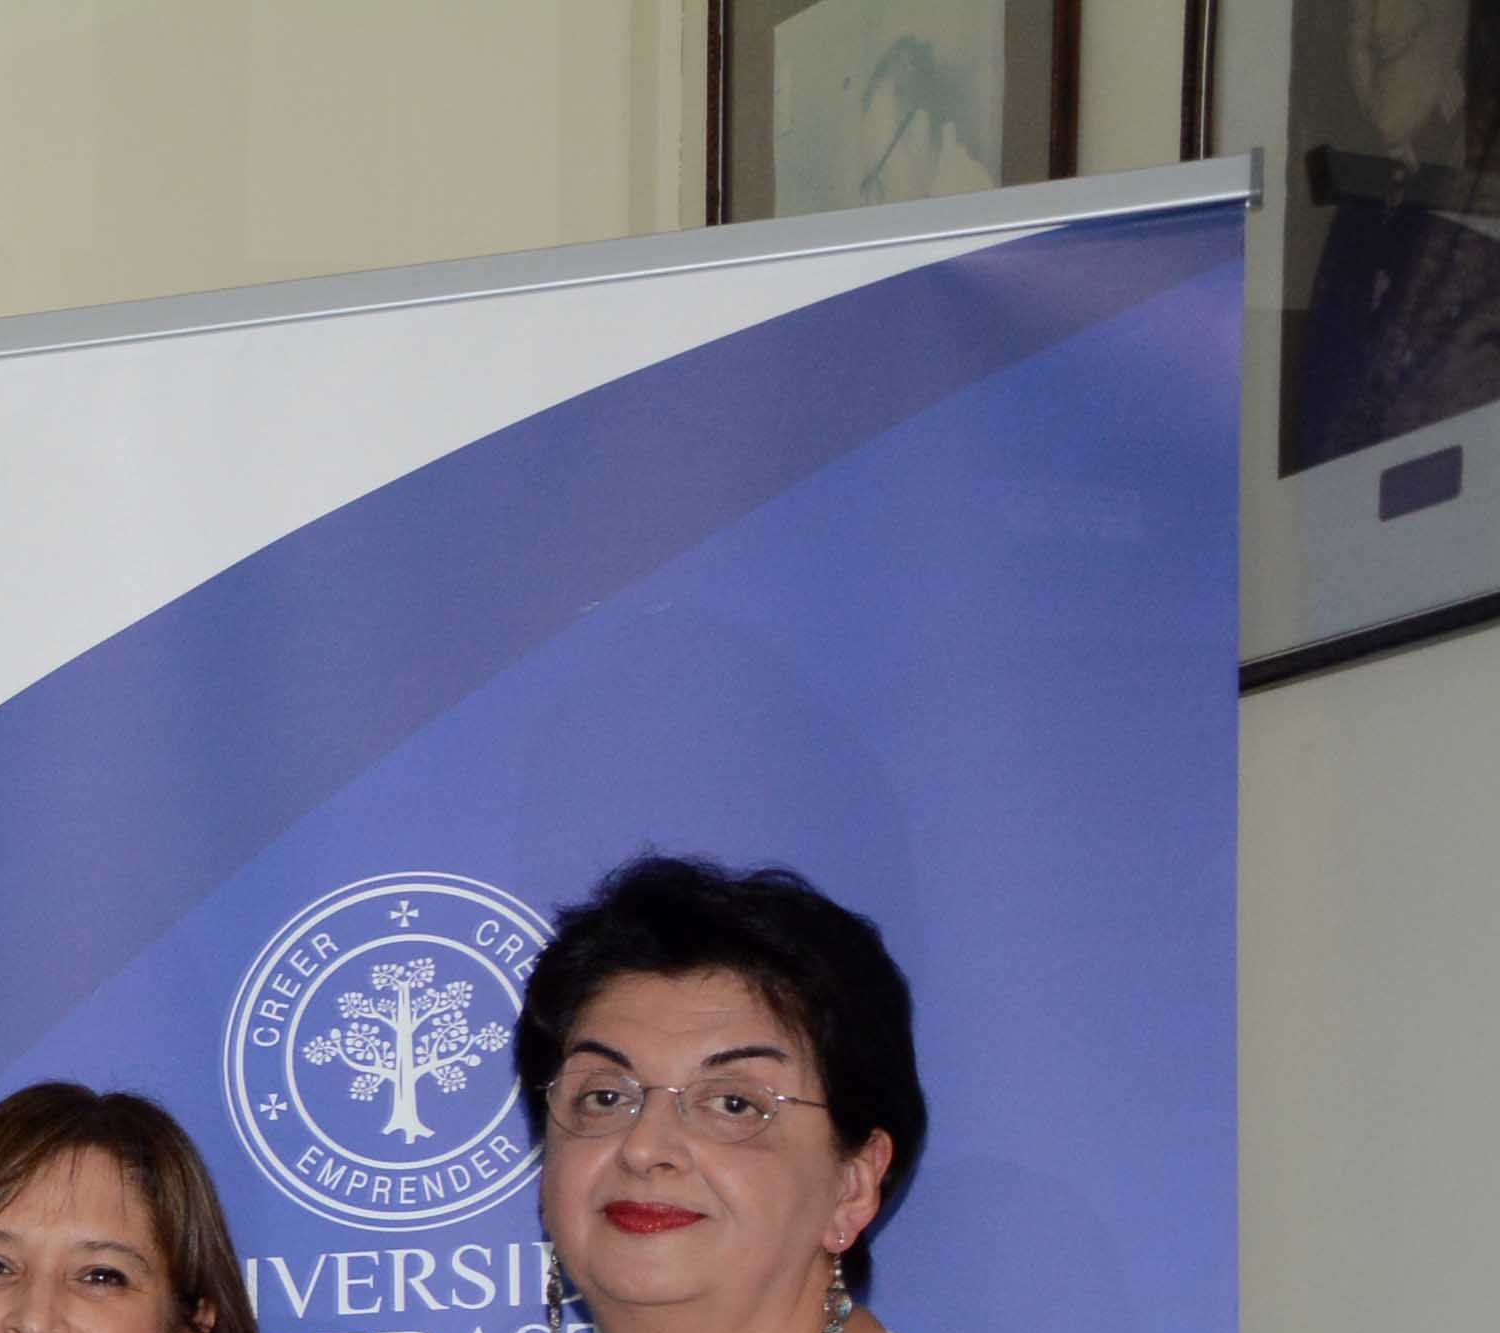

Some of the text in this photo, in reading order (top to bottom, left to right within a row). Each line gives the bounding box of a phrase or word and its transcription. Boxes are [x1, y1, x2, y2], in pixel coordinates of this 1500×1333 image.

[475, 919, 541, 981] CRE
[252, 930, 340, 1048] CREER
[295, 1134, 521, 1206] EMPRENDER
